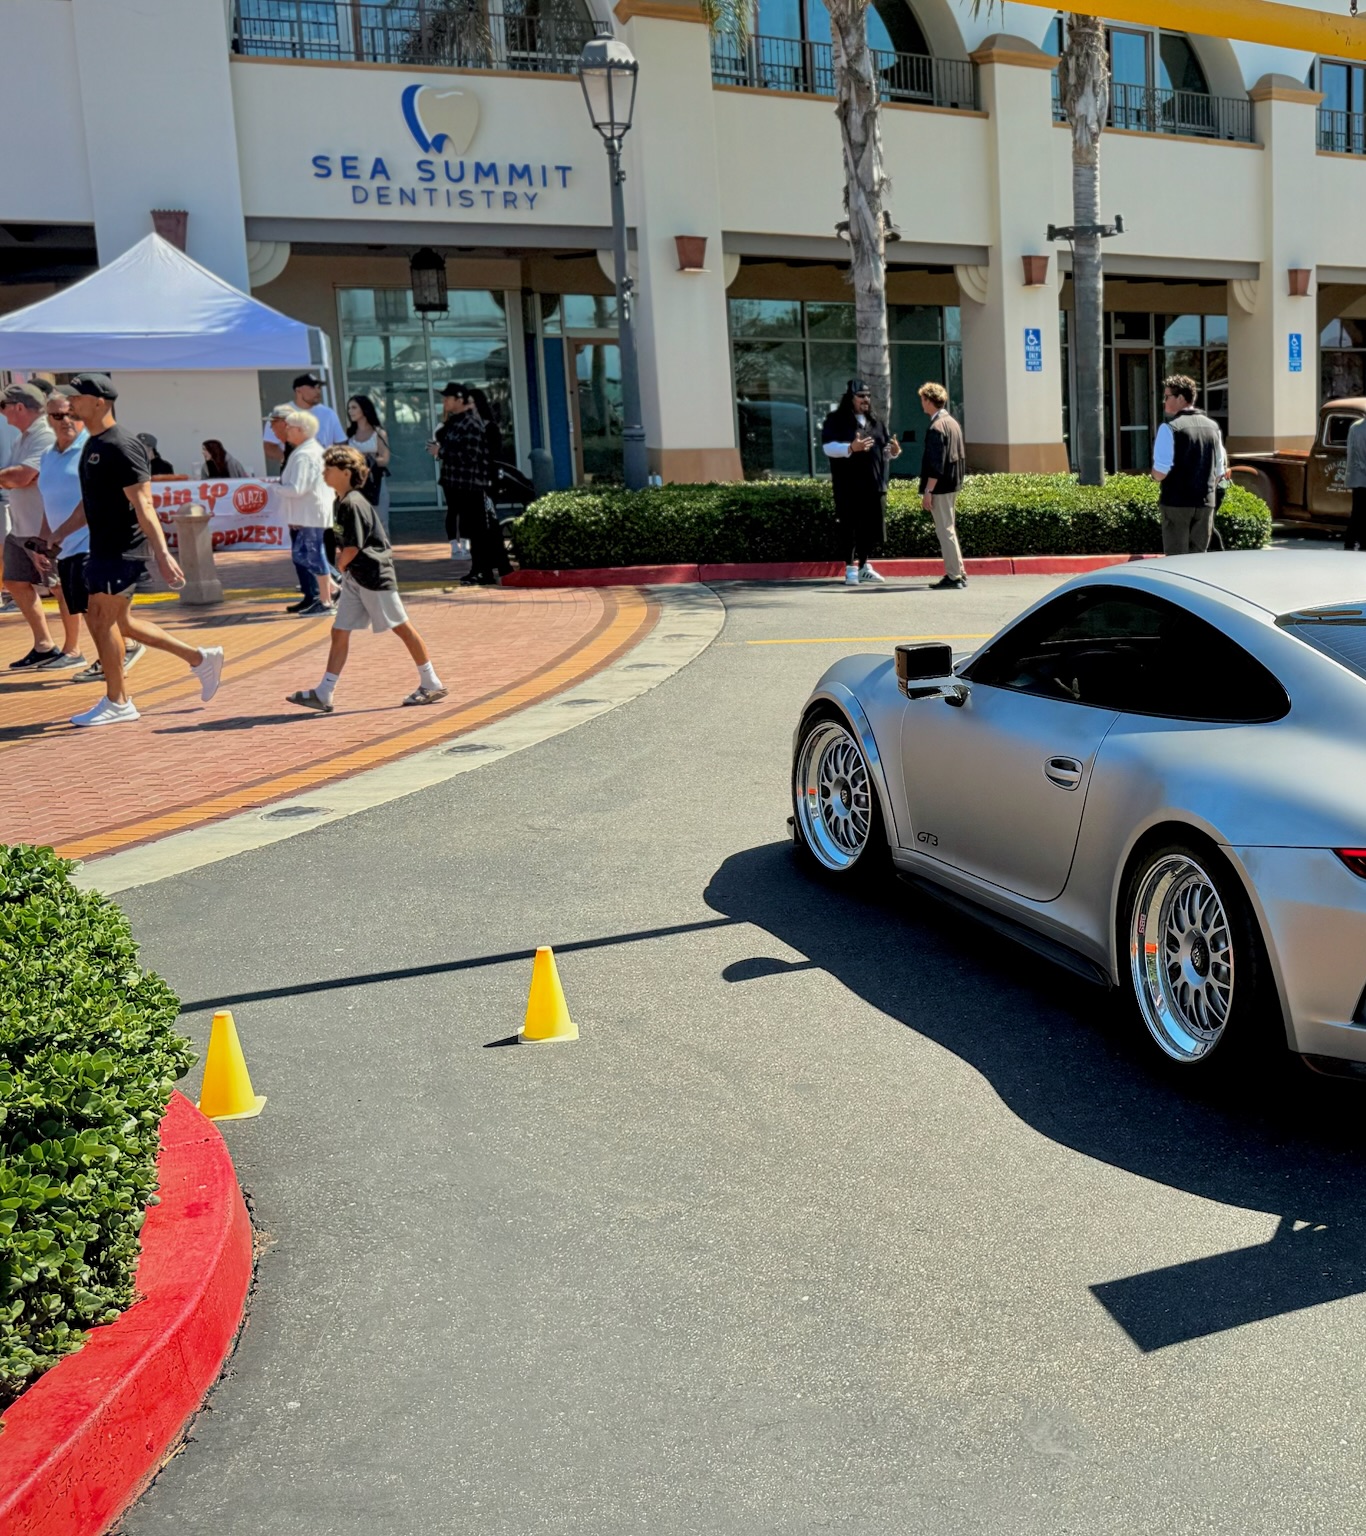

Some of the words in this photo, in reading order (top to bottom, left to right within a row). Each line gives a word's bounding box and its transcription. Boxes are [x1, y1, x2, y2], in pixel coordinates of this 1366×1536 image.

[312, 155, 391, 181] SEA
[416, 159, 573, 188] SUMMIT
[352, 185, 539, 210] DENTISTRY
[198, 482, 229, 502] to
[237, 490, 264, 506] BLAZE
[212, 524, 283, 549] PRIZES!
[917, 831, 939, 846] GT3
